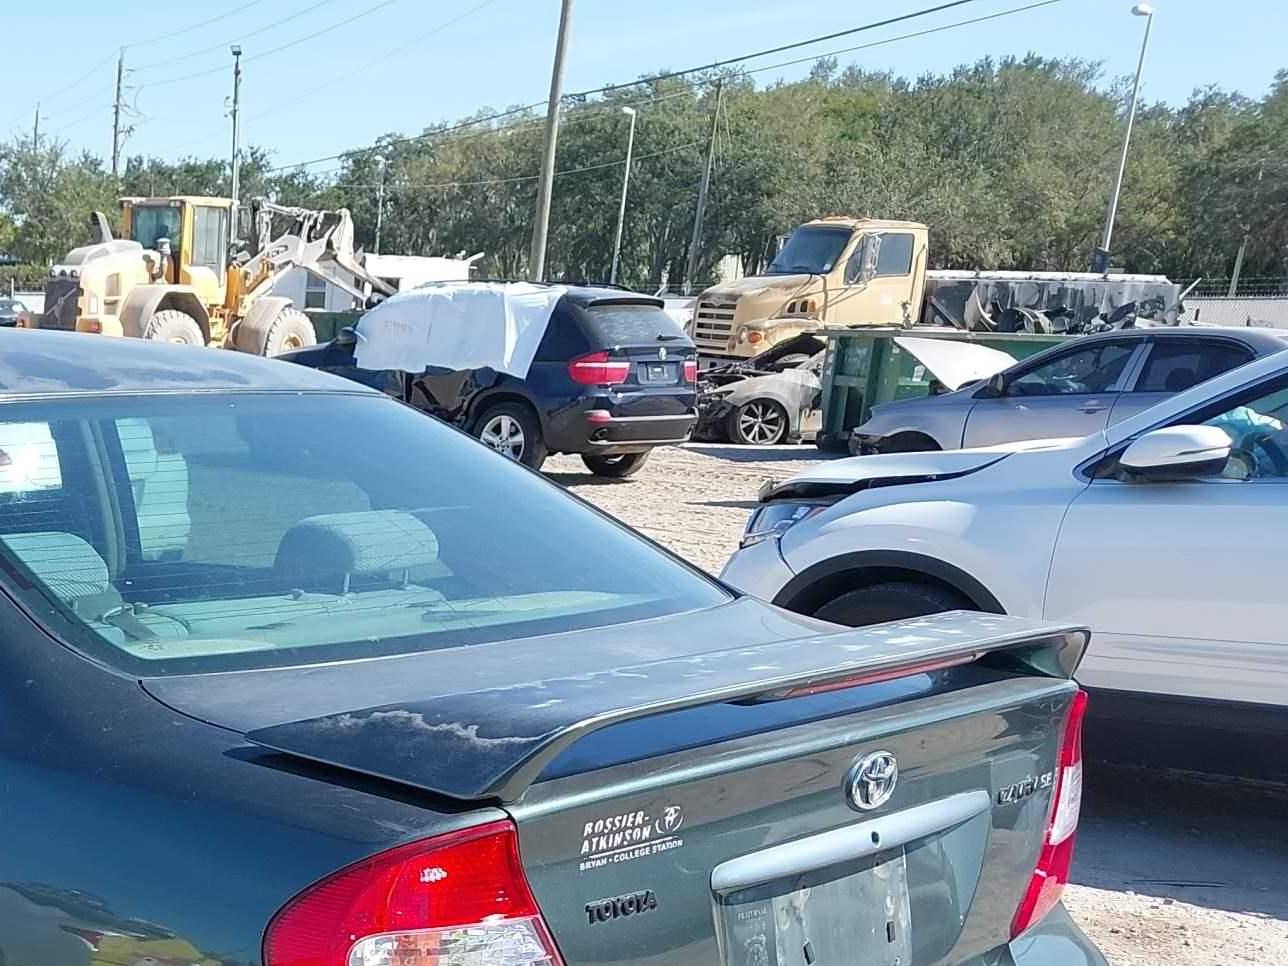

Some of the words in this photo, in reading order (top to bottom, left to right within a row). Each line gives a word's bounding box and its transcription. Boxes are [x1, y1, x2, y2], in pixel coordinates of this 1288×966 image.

[584, 811, 650, 836] ROSSIER-
[581, 825, 652, 854] ATKINSON
[579, 858, 607, 871] BRYAN
[613, 848, 650, 864] COLLEGE
[651, 839, 683, 854] STATION
[585, 890, 657, 925] TOYOTA
